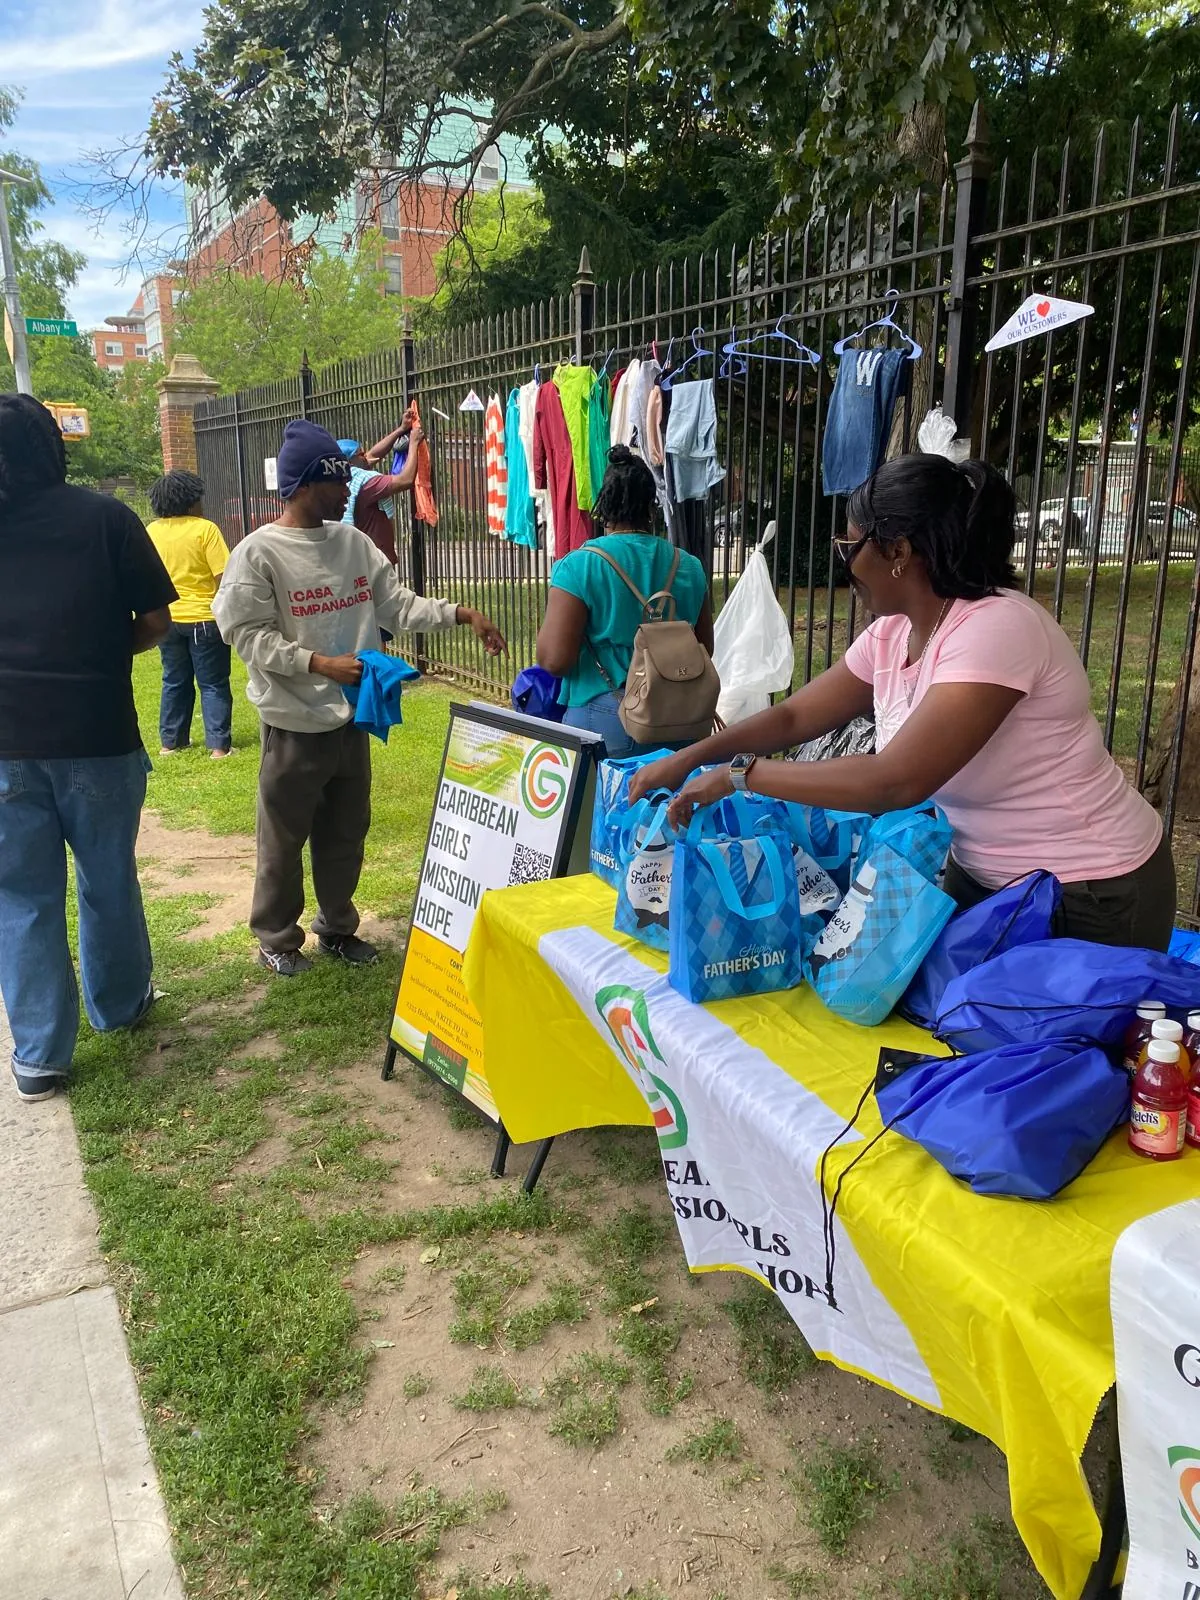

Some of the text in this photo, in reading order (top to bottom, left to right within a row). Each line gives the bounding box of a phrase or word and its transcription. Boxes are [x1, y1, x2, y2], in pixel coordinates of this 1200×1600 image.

[32, 320, 61, 335] Albany
[1007, 311, 1067, 340] OUR CUSTOMERS
[1018, 309, 1037, 327] WE
[856, 351, 883, 387] W
[320, 457, 349, 477] NY
[438, 783, 520, 838] CARIBBEAN
[431, 821, 472, 861] GIRLS
[640, 861, 663, 870] HAPPY
[423, 858, 481, 910] MISSION
[416, 896, 453, 938] HOPE
[704, 950, 786, 979] FATHER'S DAY
[739, 943, 773, 957] Happy
[664, 1159, 711, 1186] EA
